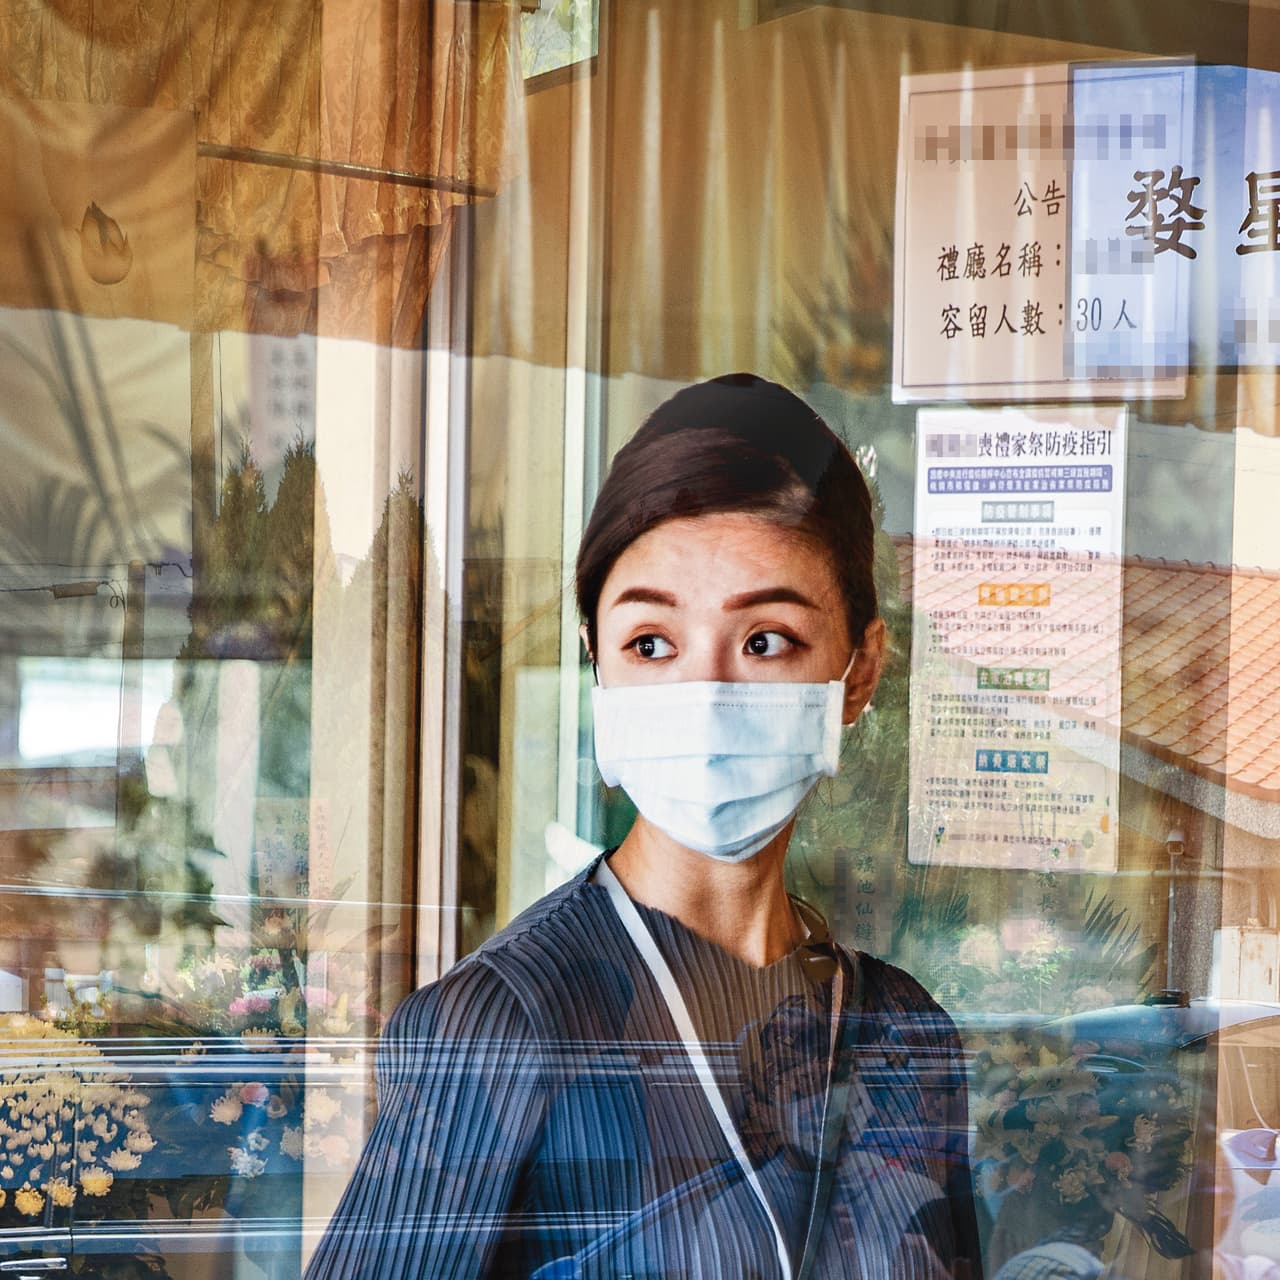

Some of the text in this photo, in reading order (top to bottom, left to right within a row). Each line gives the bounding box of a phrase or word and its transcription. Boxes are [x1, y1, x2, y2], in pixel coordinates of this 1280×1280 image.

[1013, 179, 1066, 217] 公告
[978, 429, 1112, 458] 喪禮家祭防疫指引
